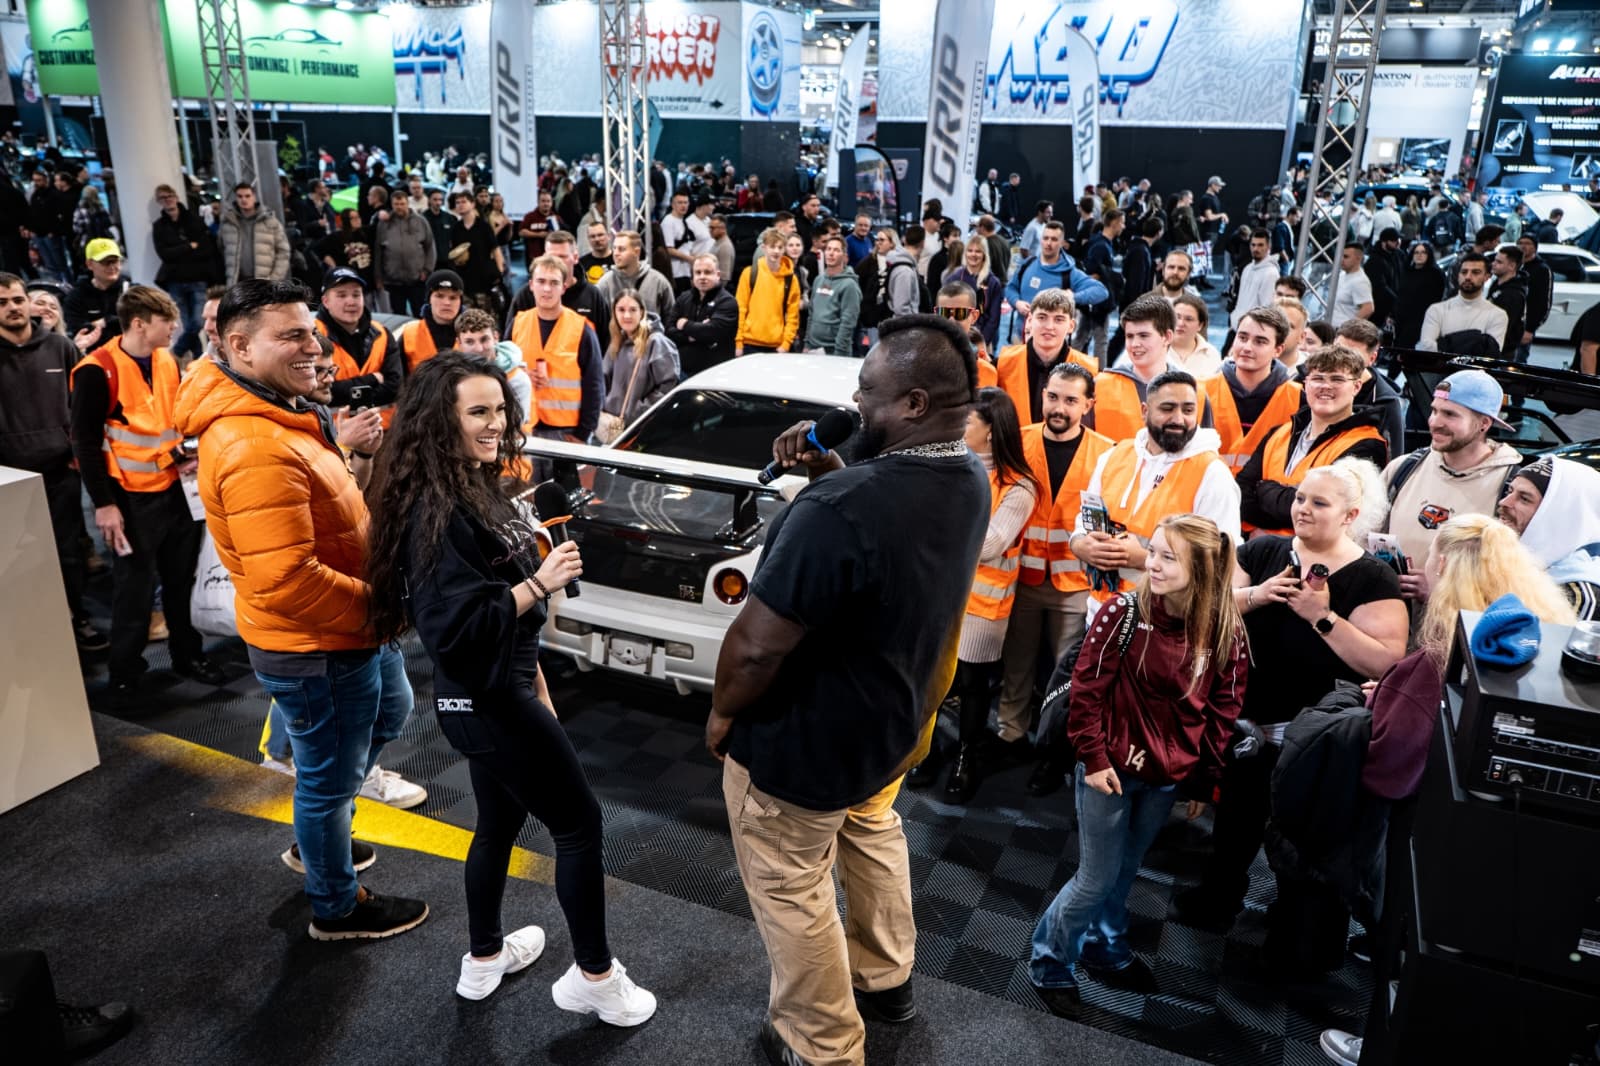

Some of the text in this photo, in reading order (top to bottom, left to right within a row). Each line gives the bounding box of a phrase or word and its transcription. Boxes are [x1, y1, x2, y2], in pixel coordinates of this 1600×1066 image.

[225, 54, 359, 78] USOMKINGZ PERFORMANCE
[1010, 81, 1131, 101] WHES
[496, 40, 521, 176] GRIP
[835, 79, 853, 152] GRIP
[930, 32, 965, 196] GRIP
[970, 61, 984, 143] MOTOREVENT
[1120, 607, 1135, 634] NEVER
[1125, 744, 1147, 772] 14
